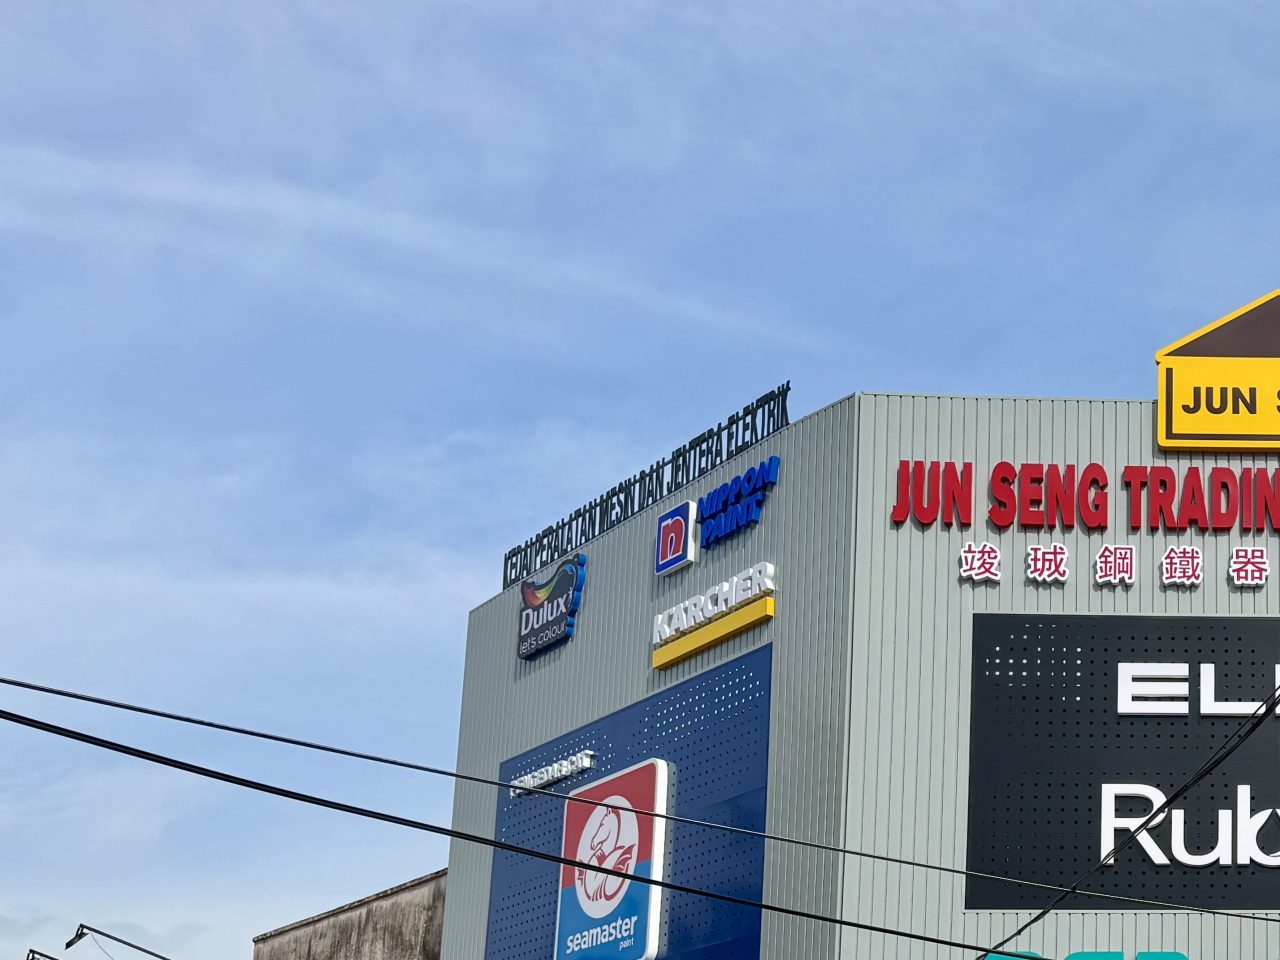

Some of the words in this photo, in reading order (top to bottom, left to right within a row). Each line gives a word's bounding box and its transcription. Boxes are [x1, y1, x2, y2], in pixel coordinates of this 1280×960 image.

[1181, 386, 1257, 415] JUN
[534, 498, 597, 572] PERALATAN
[598, 474, 637, 534] MESIN
[637, 458, 664, 513] DAN
[666, 423, 723, 492] JENTERA
[727, 380, 791, 459] ELEKTRIK
[696, 455, 780, 524] NIPPON
[891, 459, 972, 527] JUN
[988, 461, 1108, 530] SENG
[701, 492, 765, 550] PAINT
[521, 597, 567, 635] Dulux
[519, 631, 537, 654] let's
[538, 620, 566, 645] colour
[566, 914, 638, 954] seamaster
[619, 938, 634, 951] paint
